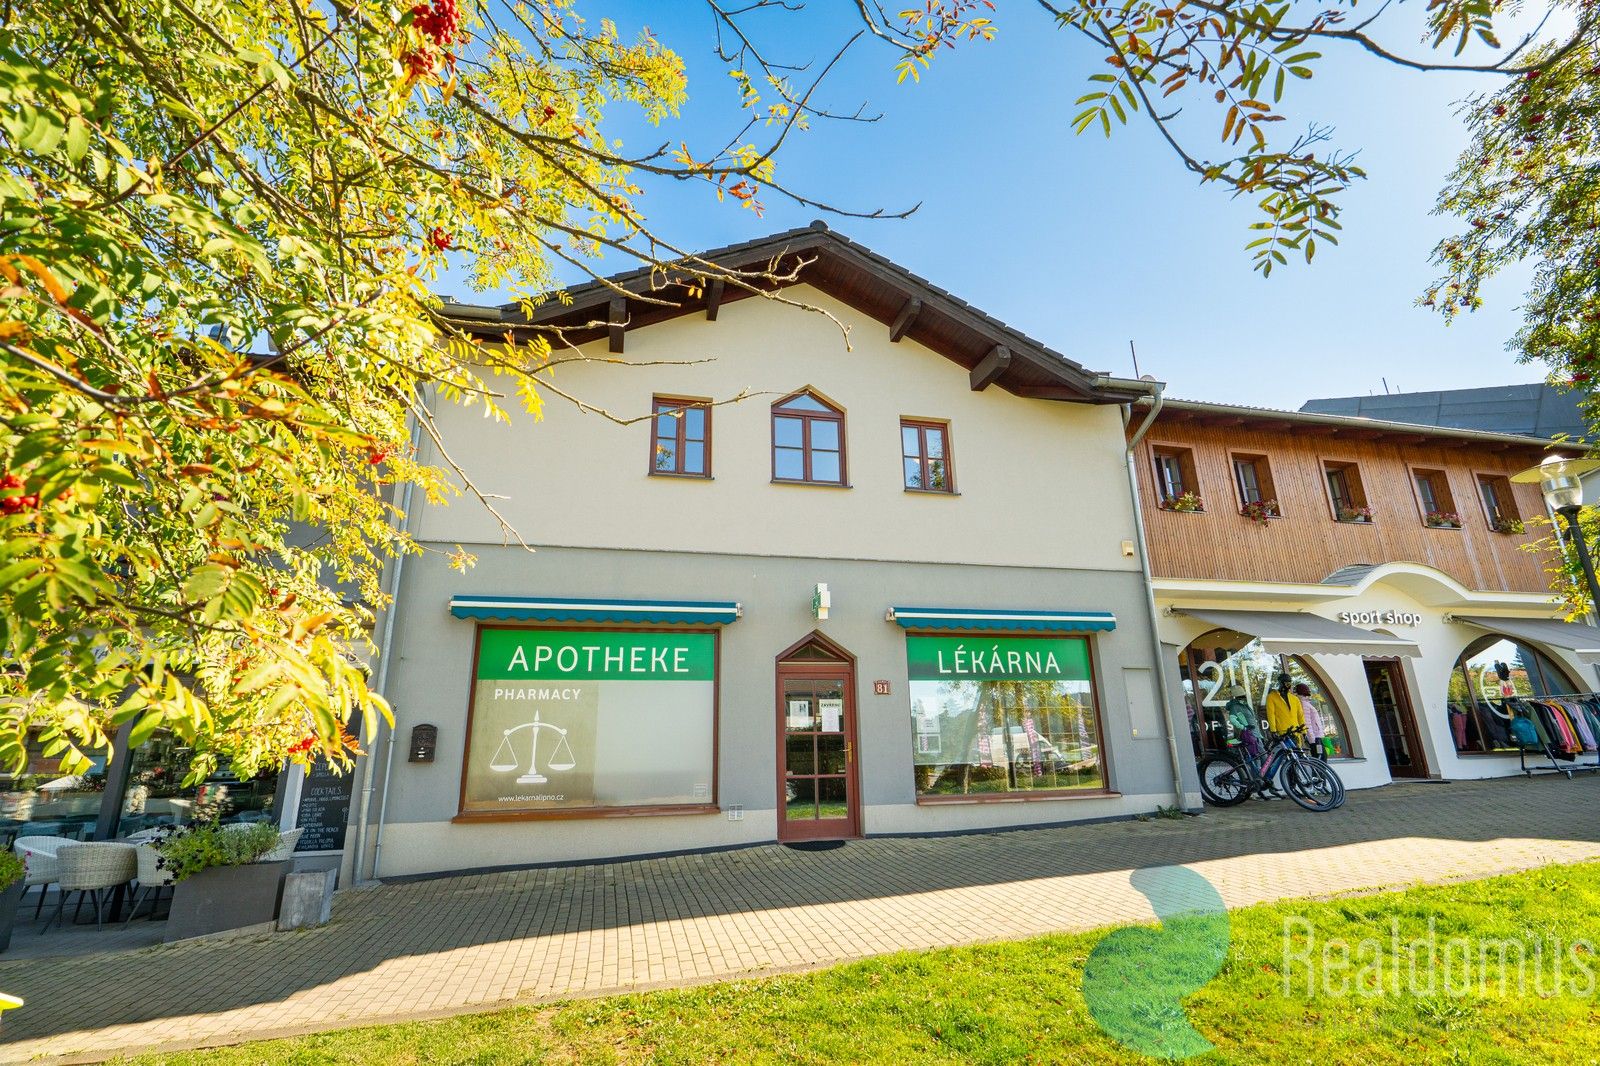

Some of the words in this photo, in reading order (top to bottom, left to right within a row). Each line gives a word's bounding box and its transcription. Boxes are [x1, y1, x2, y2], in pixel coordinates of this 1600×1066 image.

[1342, 610, 1382, 626] sport
[1386, 609, 1422, 627] shop
[507, 645, 690, 673] APOTHEKE
[938, 644, 1061, 674] LÉKÁRNA
[494, 688, 582, 700] PHARMACY
[876, 683, 888, 694] 81
